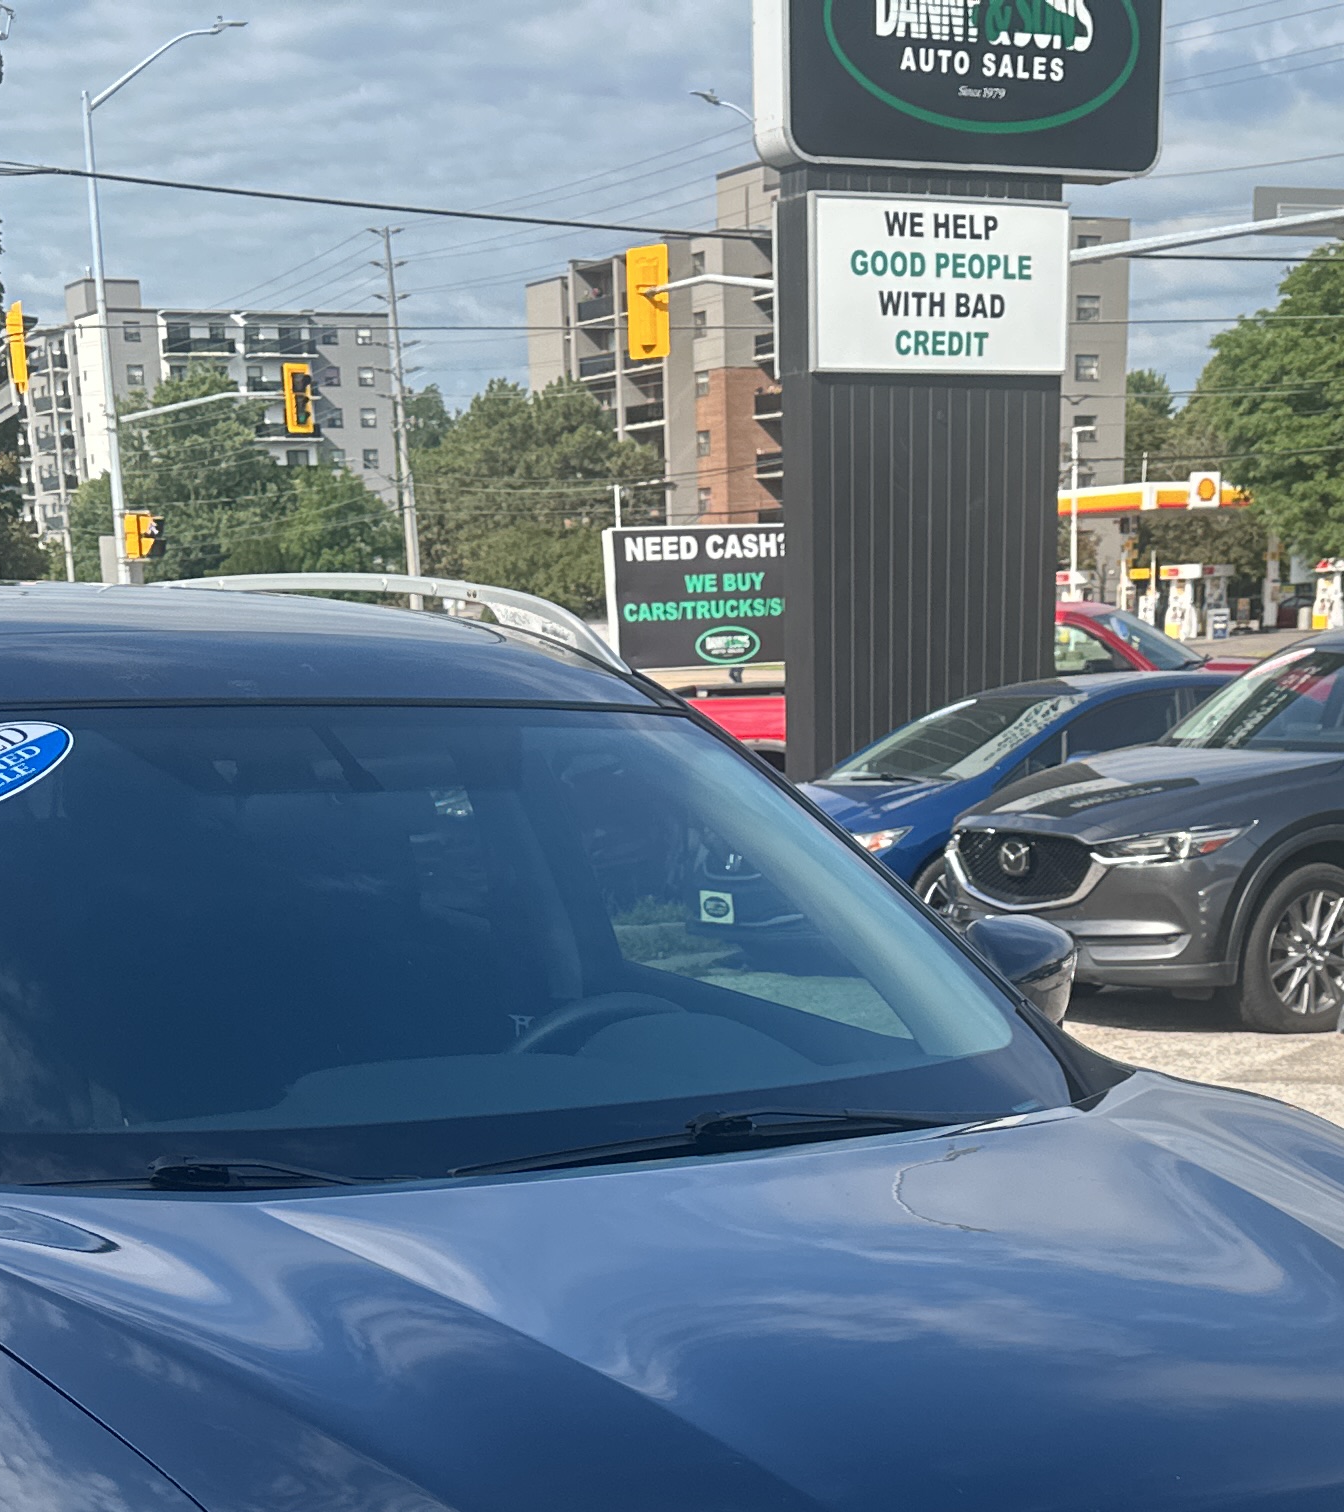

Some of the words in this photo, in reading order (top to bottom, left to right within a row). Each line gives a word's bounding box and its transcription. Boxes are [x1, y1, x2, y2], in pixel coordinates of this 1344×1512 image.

[900, 47, 970, 75] AUTO
[982, 53, 1065, 82] SALES
[885, 211, 924, 238] WE
[933, 213, 999, 241] HELP
[850, 249, 926, 278] GOOD
[935, 252, 1032, 281] PEOPLE
[878, 290, 946, 318] WITH
[955, 292, 1006, 319] BAD
[895, 329, 990, 357] CREDIT
[624, 535, 699, 562] NEED
[684, 573, 718, 594] WE
[722, 572, 765, 592] BUY
[623, 597, 785, 622] CARS/TRUCKS/S
